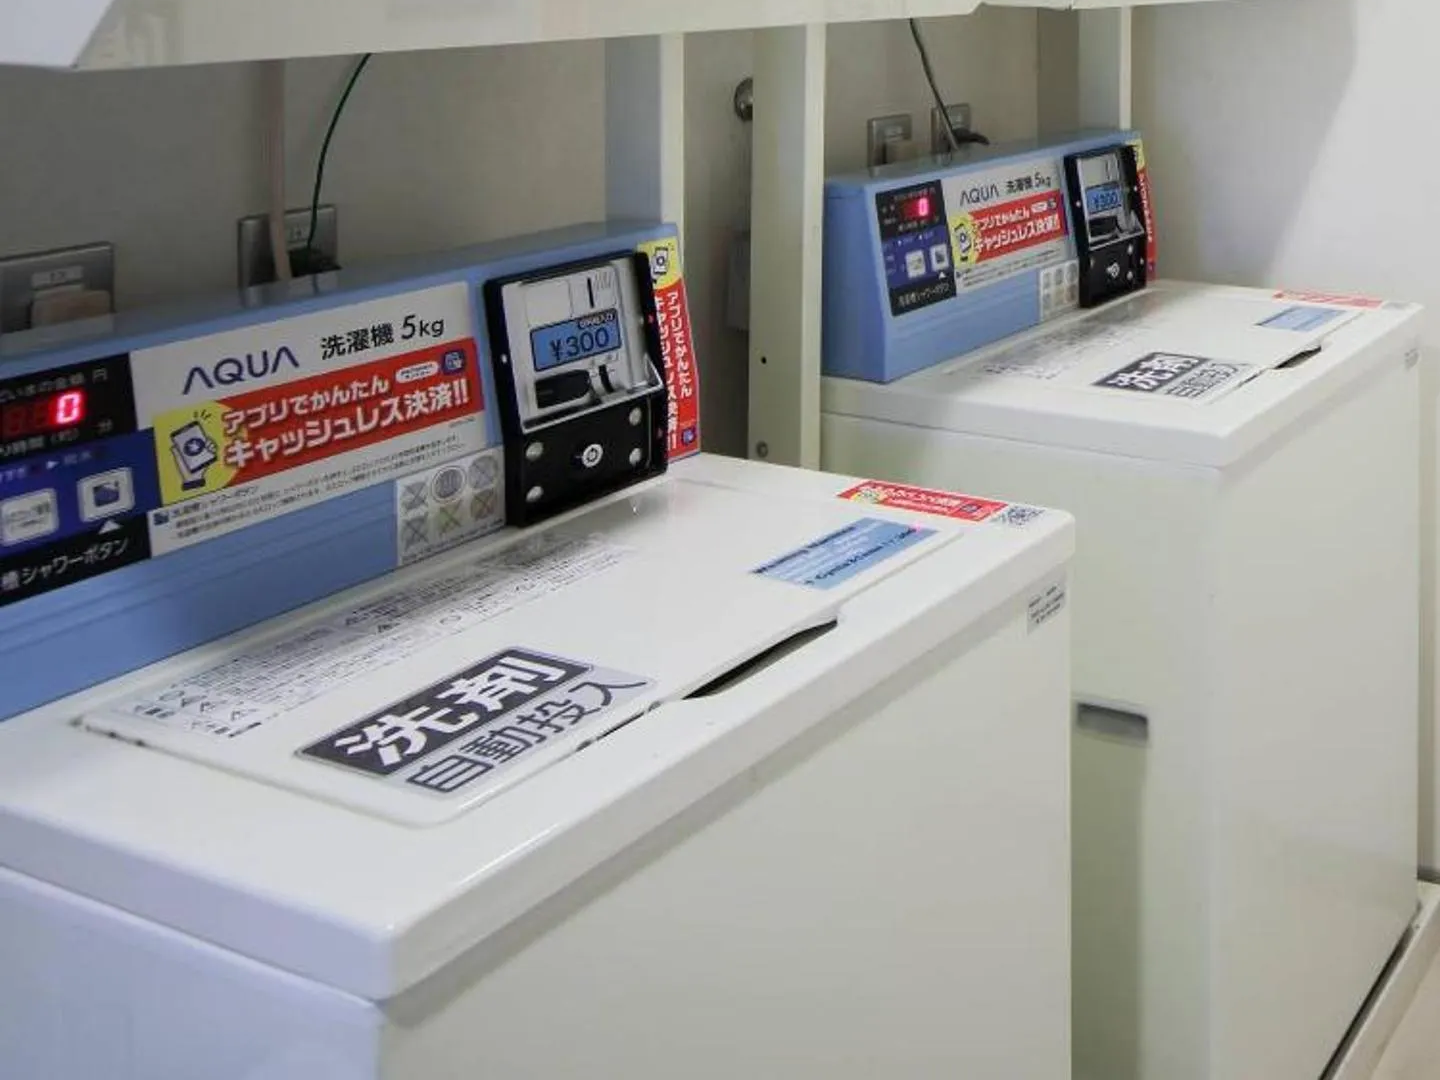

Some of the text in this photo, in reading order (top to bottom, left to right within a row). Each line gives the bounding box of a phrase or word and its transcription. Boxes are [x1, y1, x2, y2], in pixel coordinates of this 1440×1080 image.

[918, 198, 929, 216] 0
[960, 184, 999, 206] AQUA
[182, 315, 444, 395] AQUA 洗濯機 5kg
[550, 327, 609, 360] ¥300
[57, 392, 83, 424] 0
[225, 375, 389, 434] アプリでかんたん
[225, 381, 469, 469] キャッシュレス決済!!
[334, 656, 573, 768] 洗剤
[405, 678, 648, 794] 自動投入
